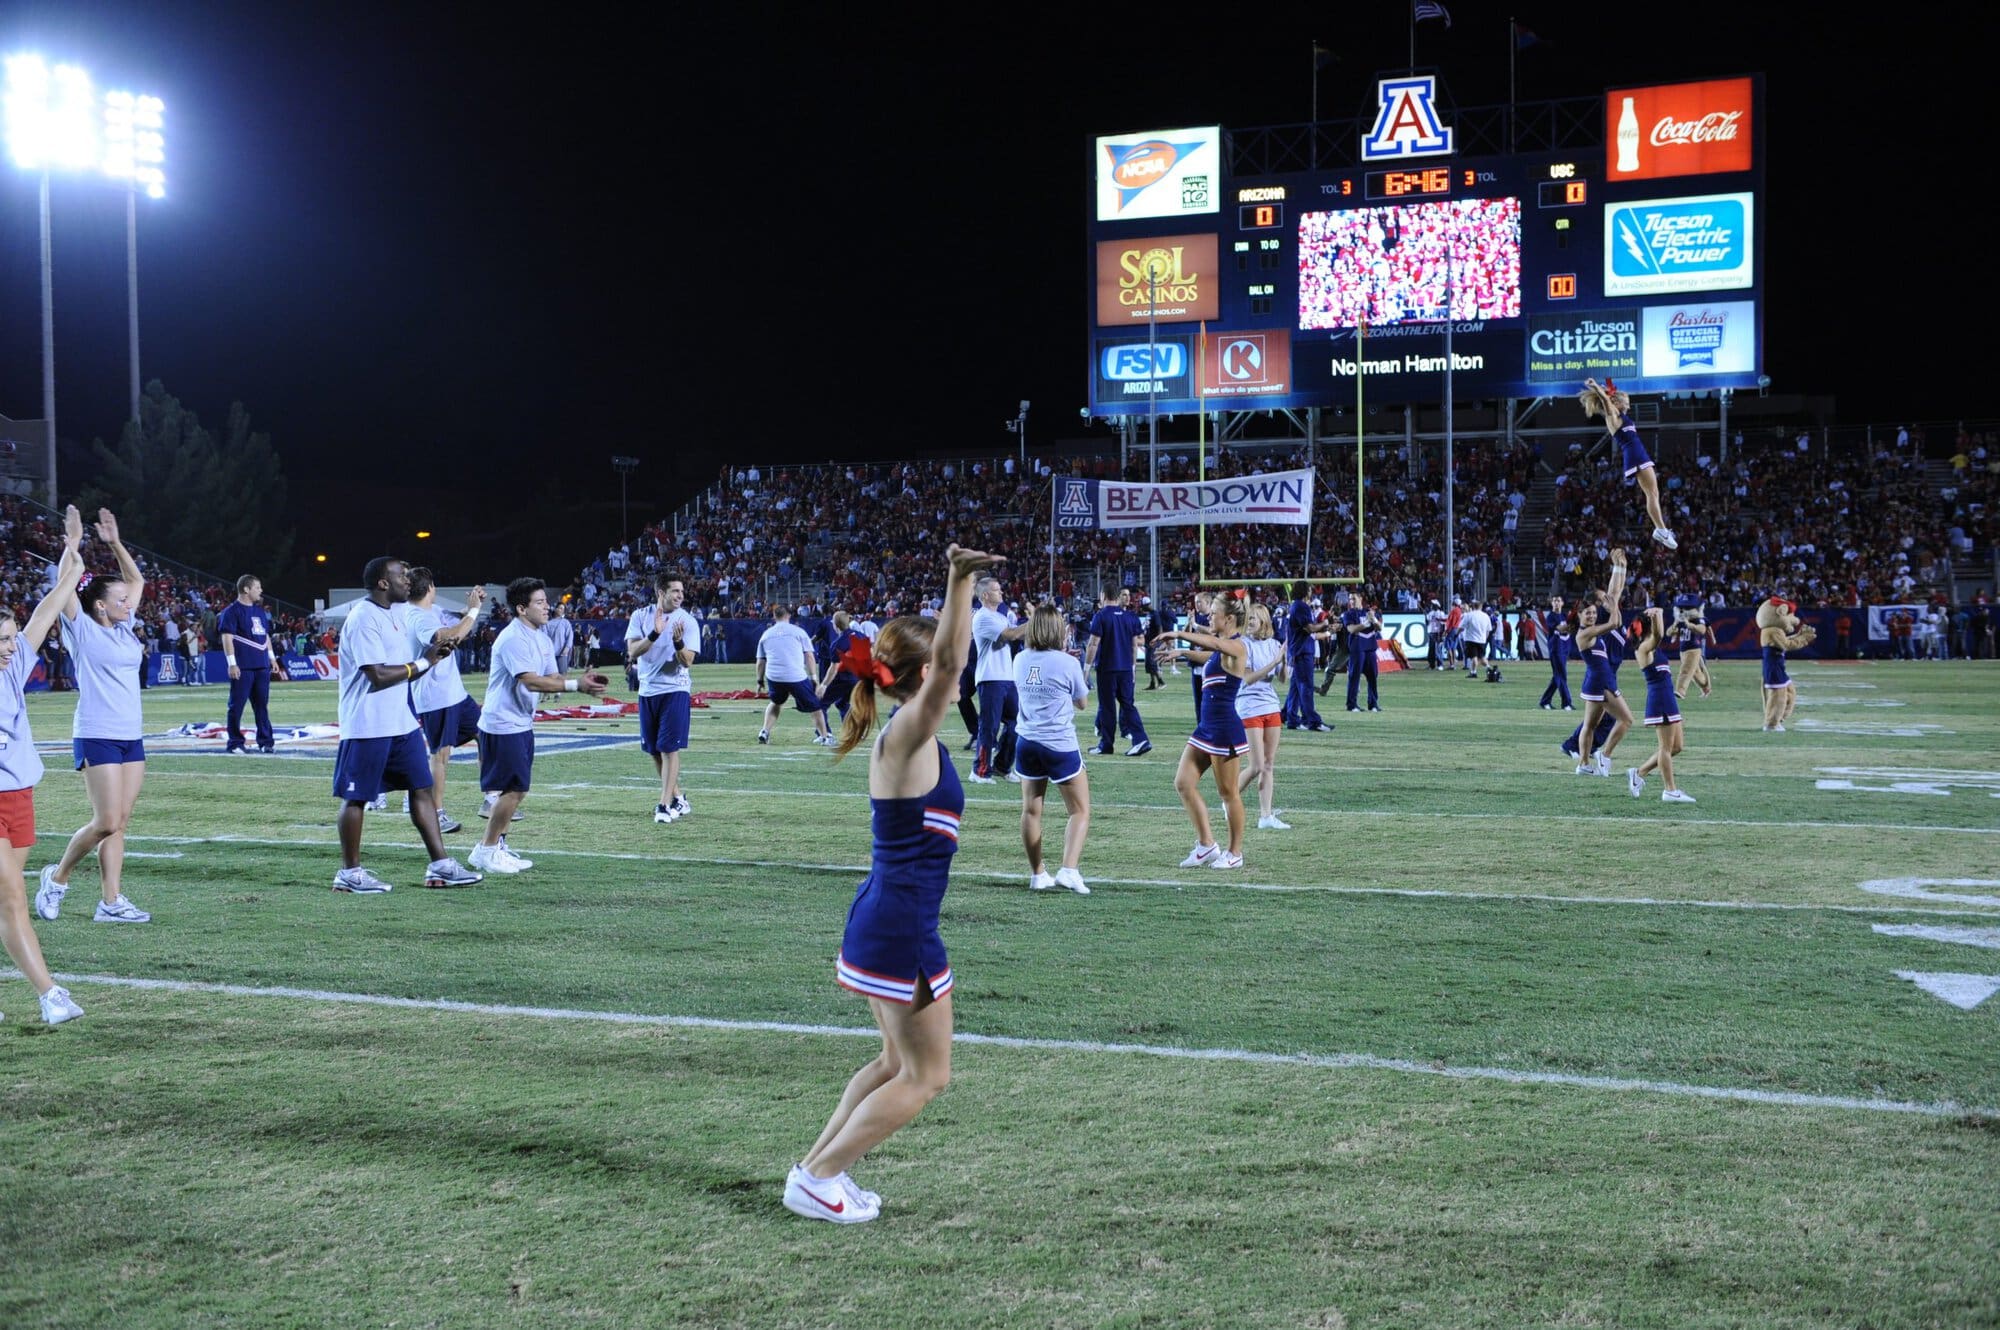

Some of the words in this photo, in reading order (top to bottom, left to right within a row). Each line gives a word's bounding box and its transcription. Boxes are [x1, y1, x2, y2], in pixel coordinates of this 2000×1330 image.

[1362, 75, 1453, 161] A
[1464, 170, 1474, 186] 3
[1477, 172, 1497, 181] TOL
[1550, 164, 1575, 178] USC
[1320, 185, 1340, 194] TOL
[1342, 180, 1351, 195] 3
[1385, 169, 1448, 195] 6:46
[1183, 191, 1207, 203] 10
[1239, 187, 1285, 202] ARIZONA
[1566, 182, 1585, 204] 0
[1256, 207, 1273, 226] 0
[1645, 213, 1713, 232] Tucson
[1651, 227, 1732, 248] Electric
[1659, 247, 1731, 265] Power
[1120, 247, 1197, 289] SOL
[1120, 285, 1198, 305] CASINOS
[1249, 285, 1264, 295] BALL
[1550, 275, 1575, 298] 00
[1132, 308, 1186, 317] SOLCAINOS.COM
[1350, 322, 1484, 339] AZONAATHLETICS.COM
[1581, 320, 1635, 334] Tucson
[1531, 328, 1637, 355] Citizen
[1673, 335, 1720, 344] TAILGATE
[1115, 347, 1173, 375] FSN
[1230, 344, 1256, 378] K
[1405, 353, 1483, 373] Hamlton
[1531, 361, 1554, 370] Miss
[1556, 362, 1562, 370] a
[1564, 360, 1584, 370] day.
[1586, 359, 1610, 368] Miss
[1620, 357, 1636, 367] lot.
[1059, 481, 1092, 515] A
[1059, 517, 1093, 527] CLUB
[158, 654, 178, 682] A
[1026, 666, 1042, 685] A
